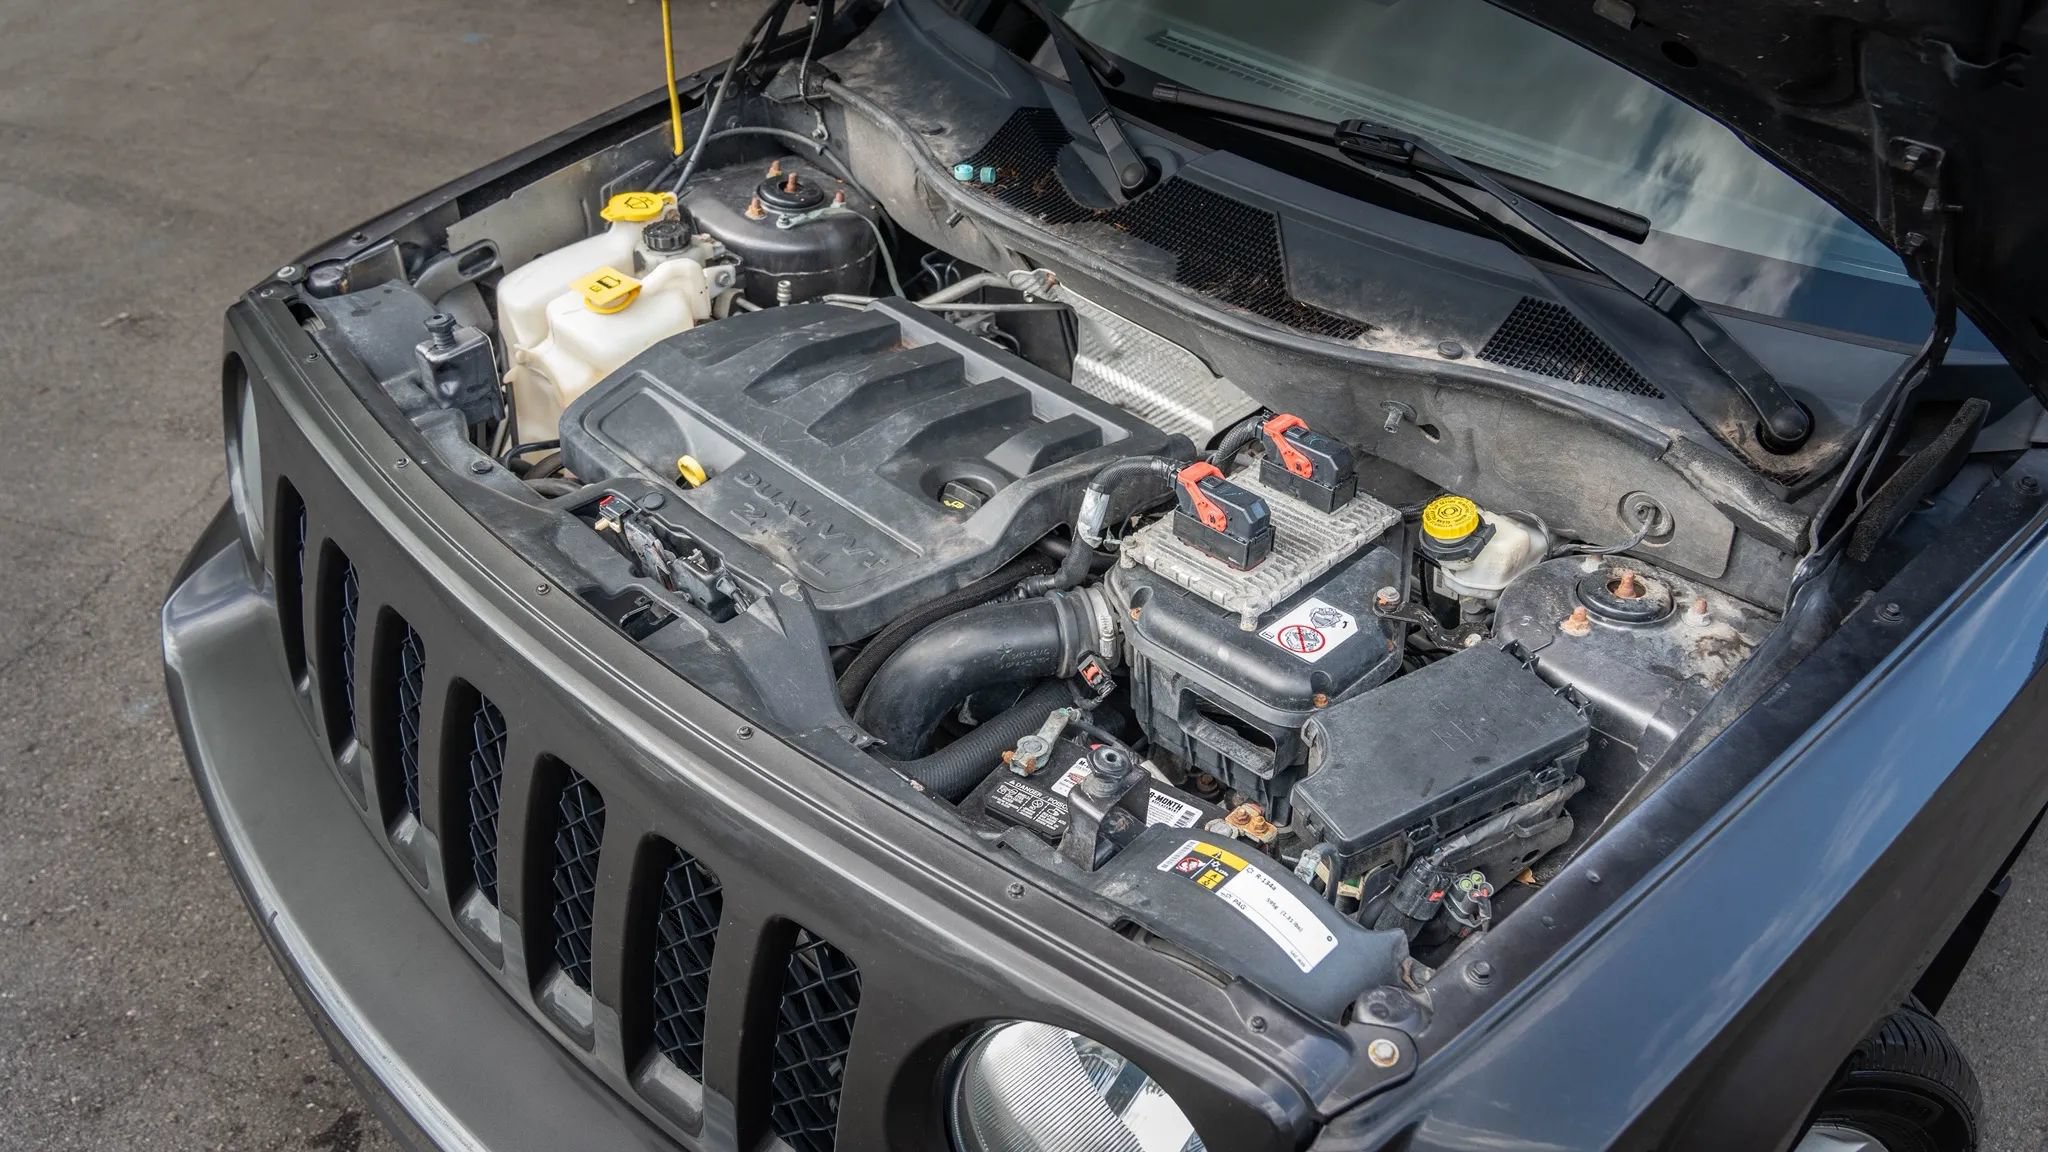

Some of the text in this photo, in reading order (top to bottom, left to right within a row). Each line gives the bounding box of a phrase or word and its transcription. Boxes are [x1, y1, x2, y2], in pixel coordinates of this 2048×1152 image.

[733, 469, 816, 528] DUAL
[1015, 781, 1043, 797] DANGER
[1047, 797, 1069, 811] POISO
[1233, 898, 1247, 911] PAG
